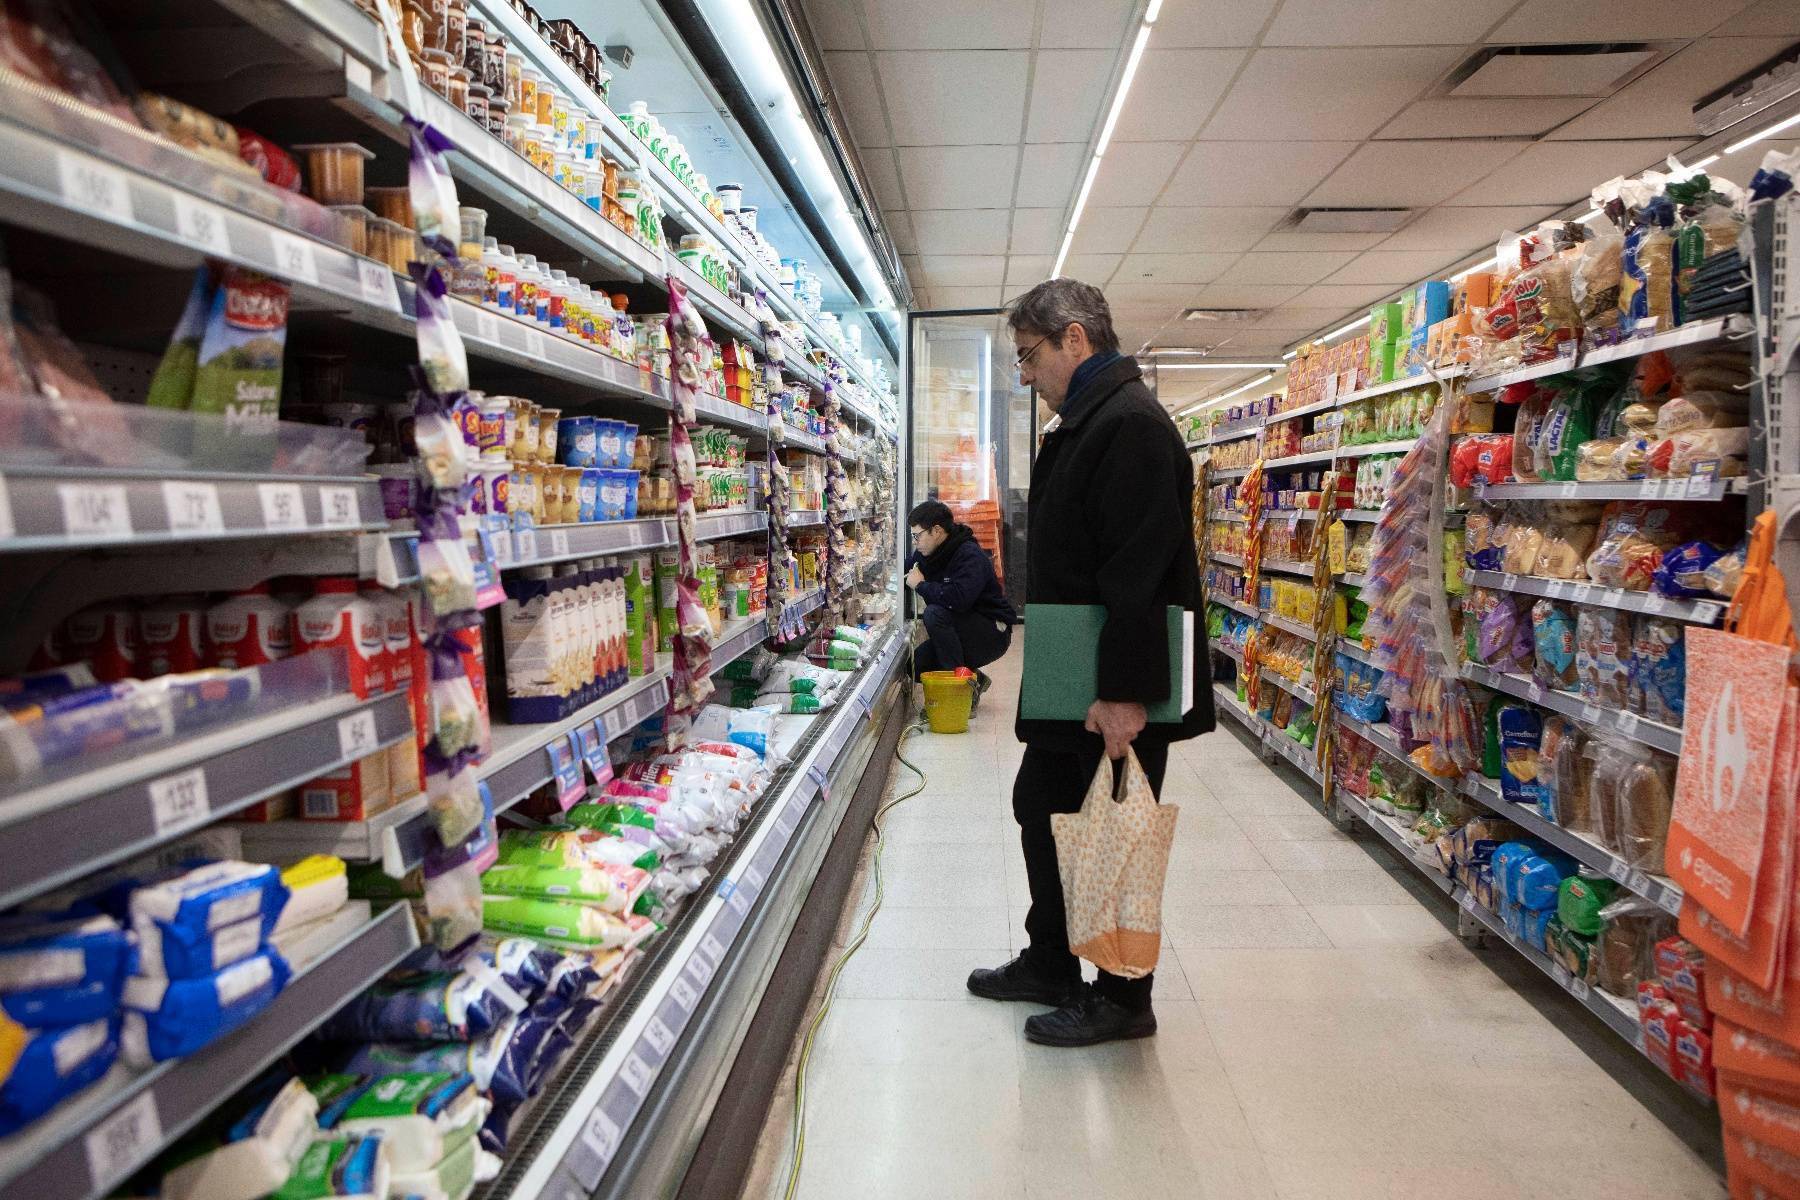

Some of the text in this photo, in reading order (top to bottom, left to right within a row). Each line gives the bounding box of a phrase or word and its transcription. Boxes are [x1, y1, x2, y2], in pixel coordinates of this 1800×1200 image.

[1688, 232, 1697, 265] Carrefour
[1548, 407, 1568, 452] LACTAL
[1503, 729, 1539, 738] Carrefour
